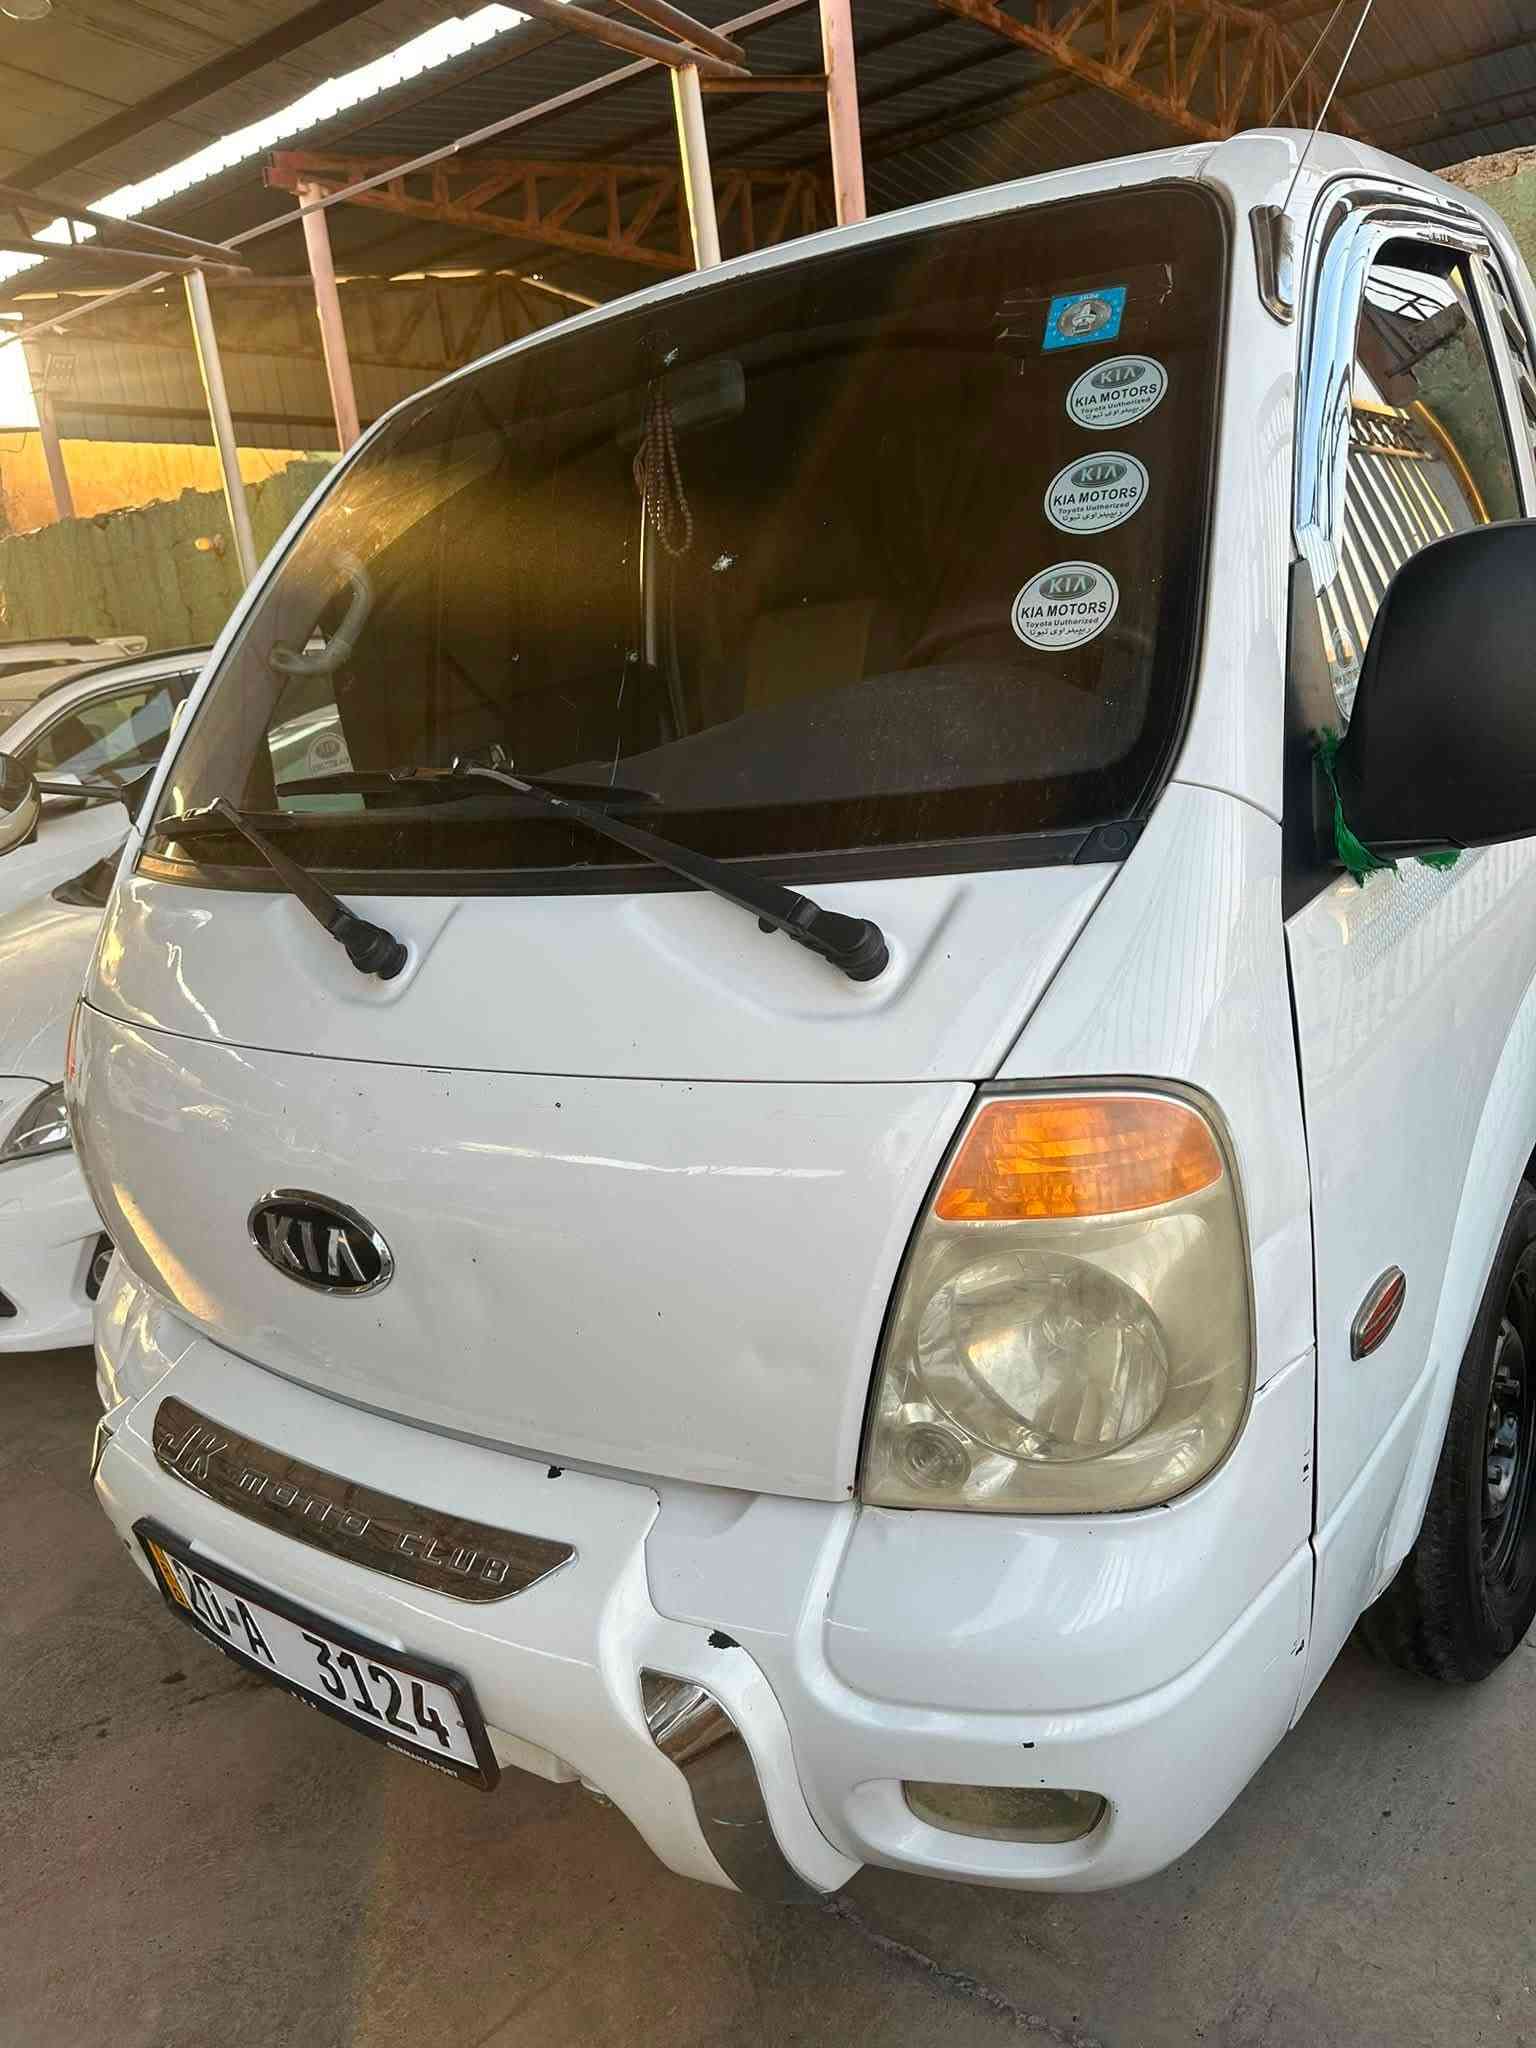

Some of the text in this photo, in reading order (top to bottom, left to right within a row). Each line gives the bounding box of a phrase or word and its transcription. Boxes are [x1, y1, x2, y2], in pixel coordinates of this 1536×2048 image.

[1101, 367, 1136, 384] KIA
[1075, 384, 1157, 407] KIA MOTORS
[1081, 465, 1117, 482] KIA
[1054, 486, 1137, 506] KIA MOTORS
[1059, 506, 1085, 515] Toyota
[1049, 576, 1087, 593] KIA
[1021, 601, 1106, 619] KIA MOTORS
[1026, 620, 1052, 630] Toyota
[263, 1211, 367, 1282] KIA
[157, 1424, 228, 1480] JK
[393, 1529, 510, 1583] CLUB
[302, 1632, 451, 1748] 3124
